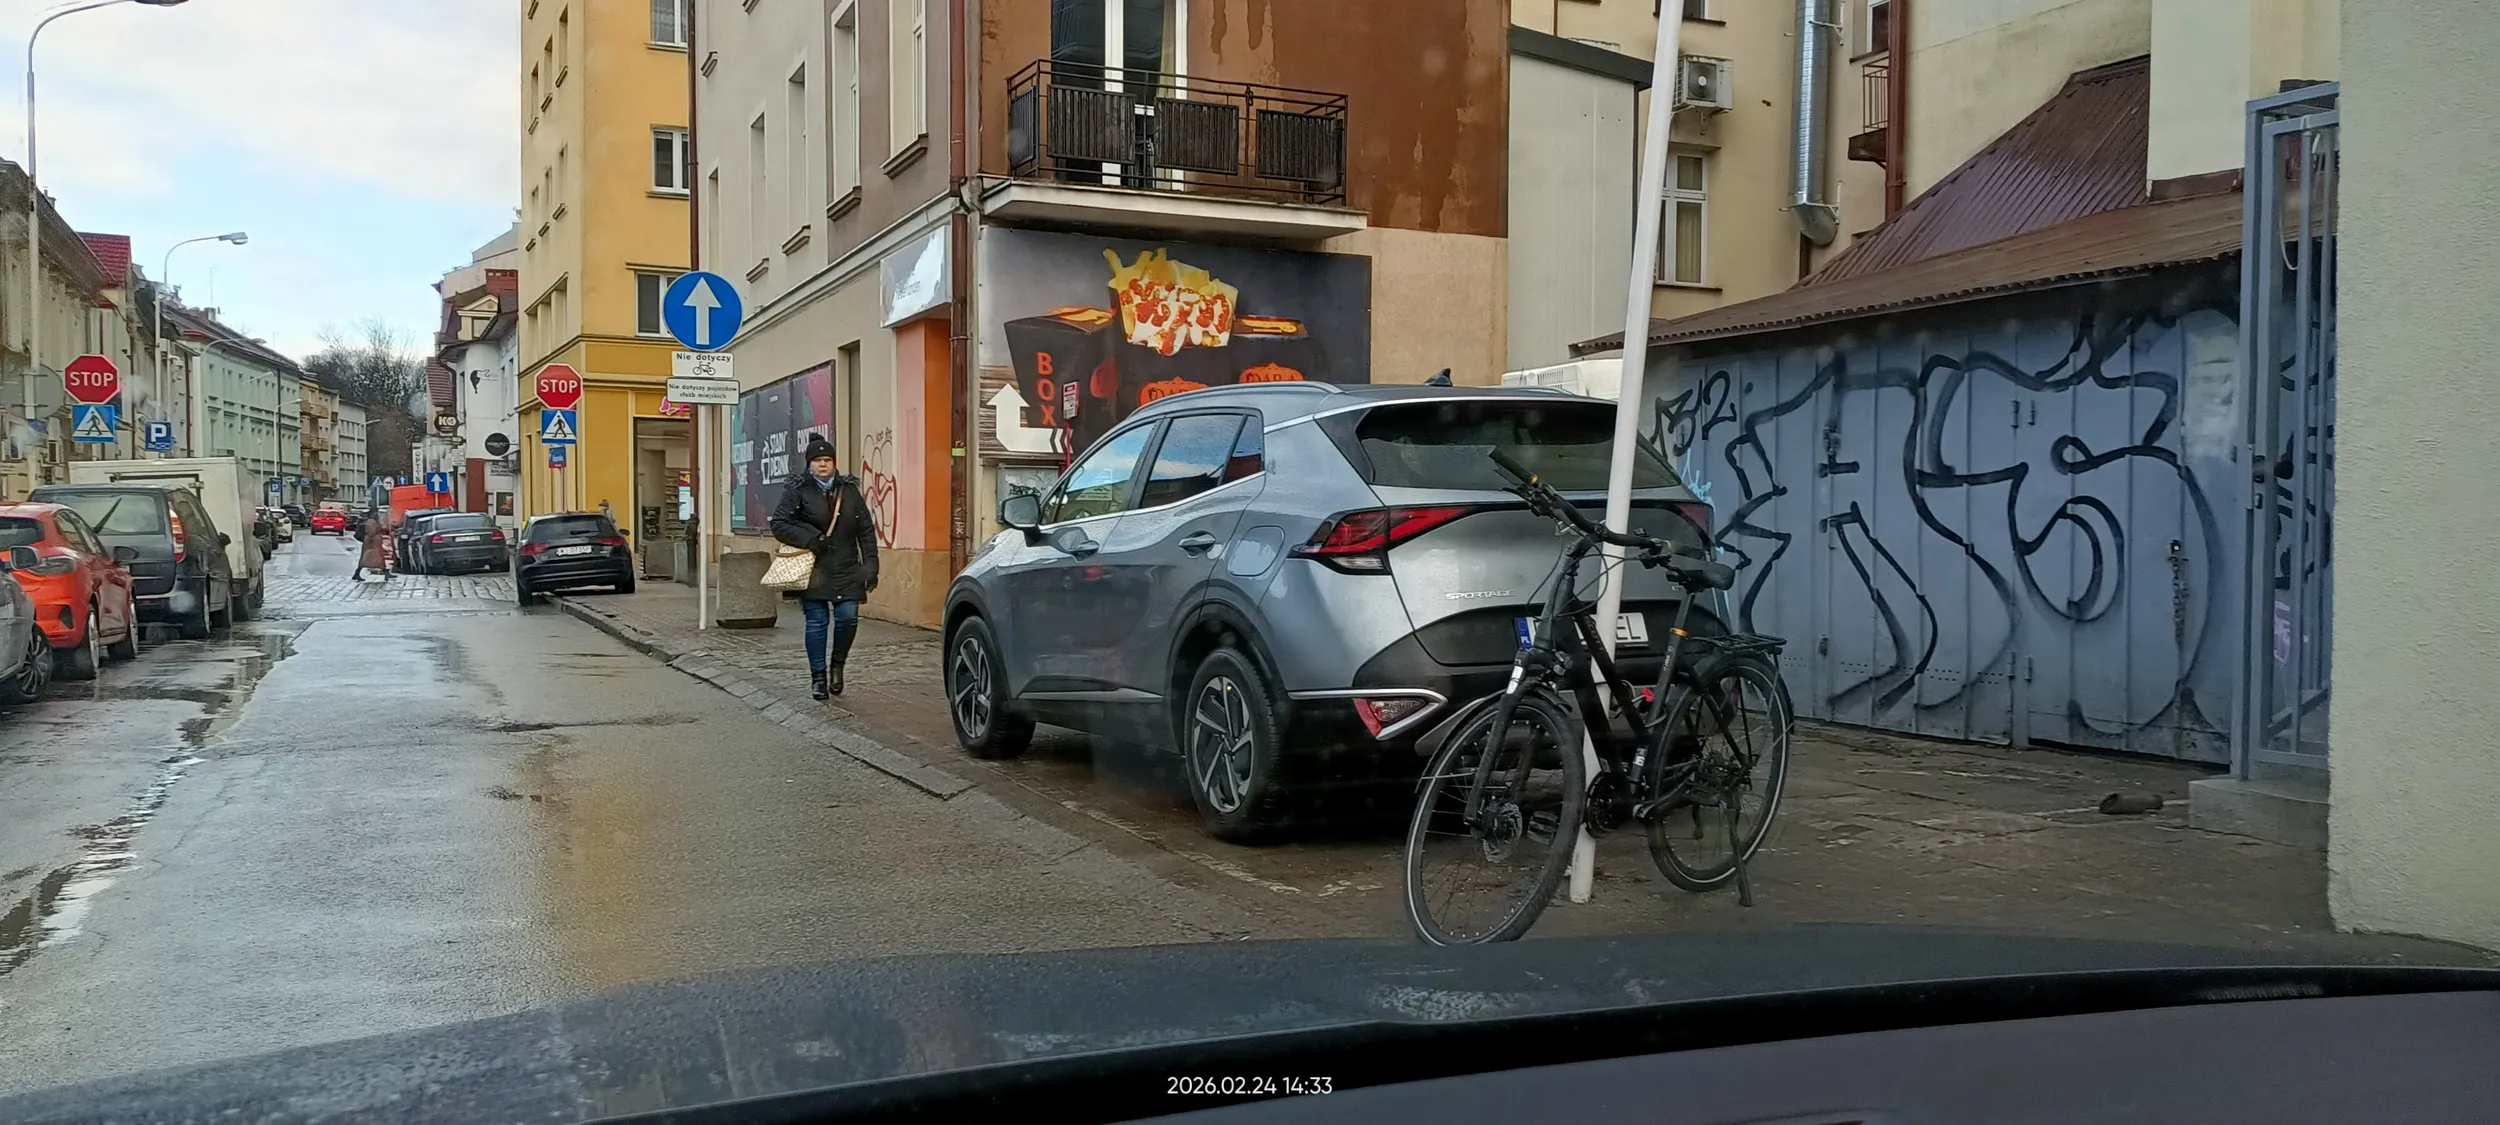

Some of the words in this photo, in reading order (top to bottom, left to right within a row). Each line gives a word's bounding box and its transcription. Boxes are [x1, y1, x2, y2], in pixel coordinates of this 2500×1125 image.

[696, 354, 731, 362] dotyczy
[69, 371, 114, 387] STOP
[540, 379, 578, 394] STOP
[150, 423, 167, 442] P
